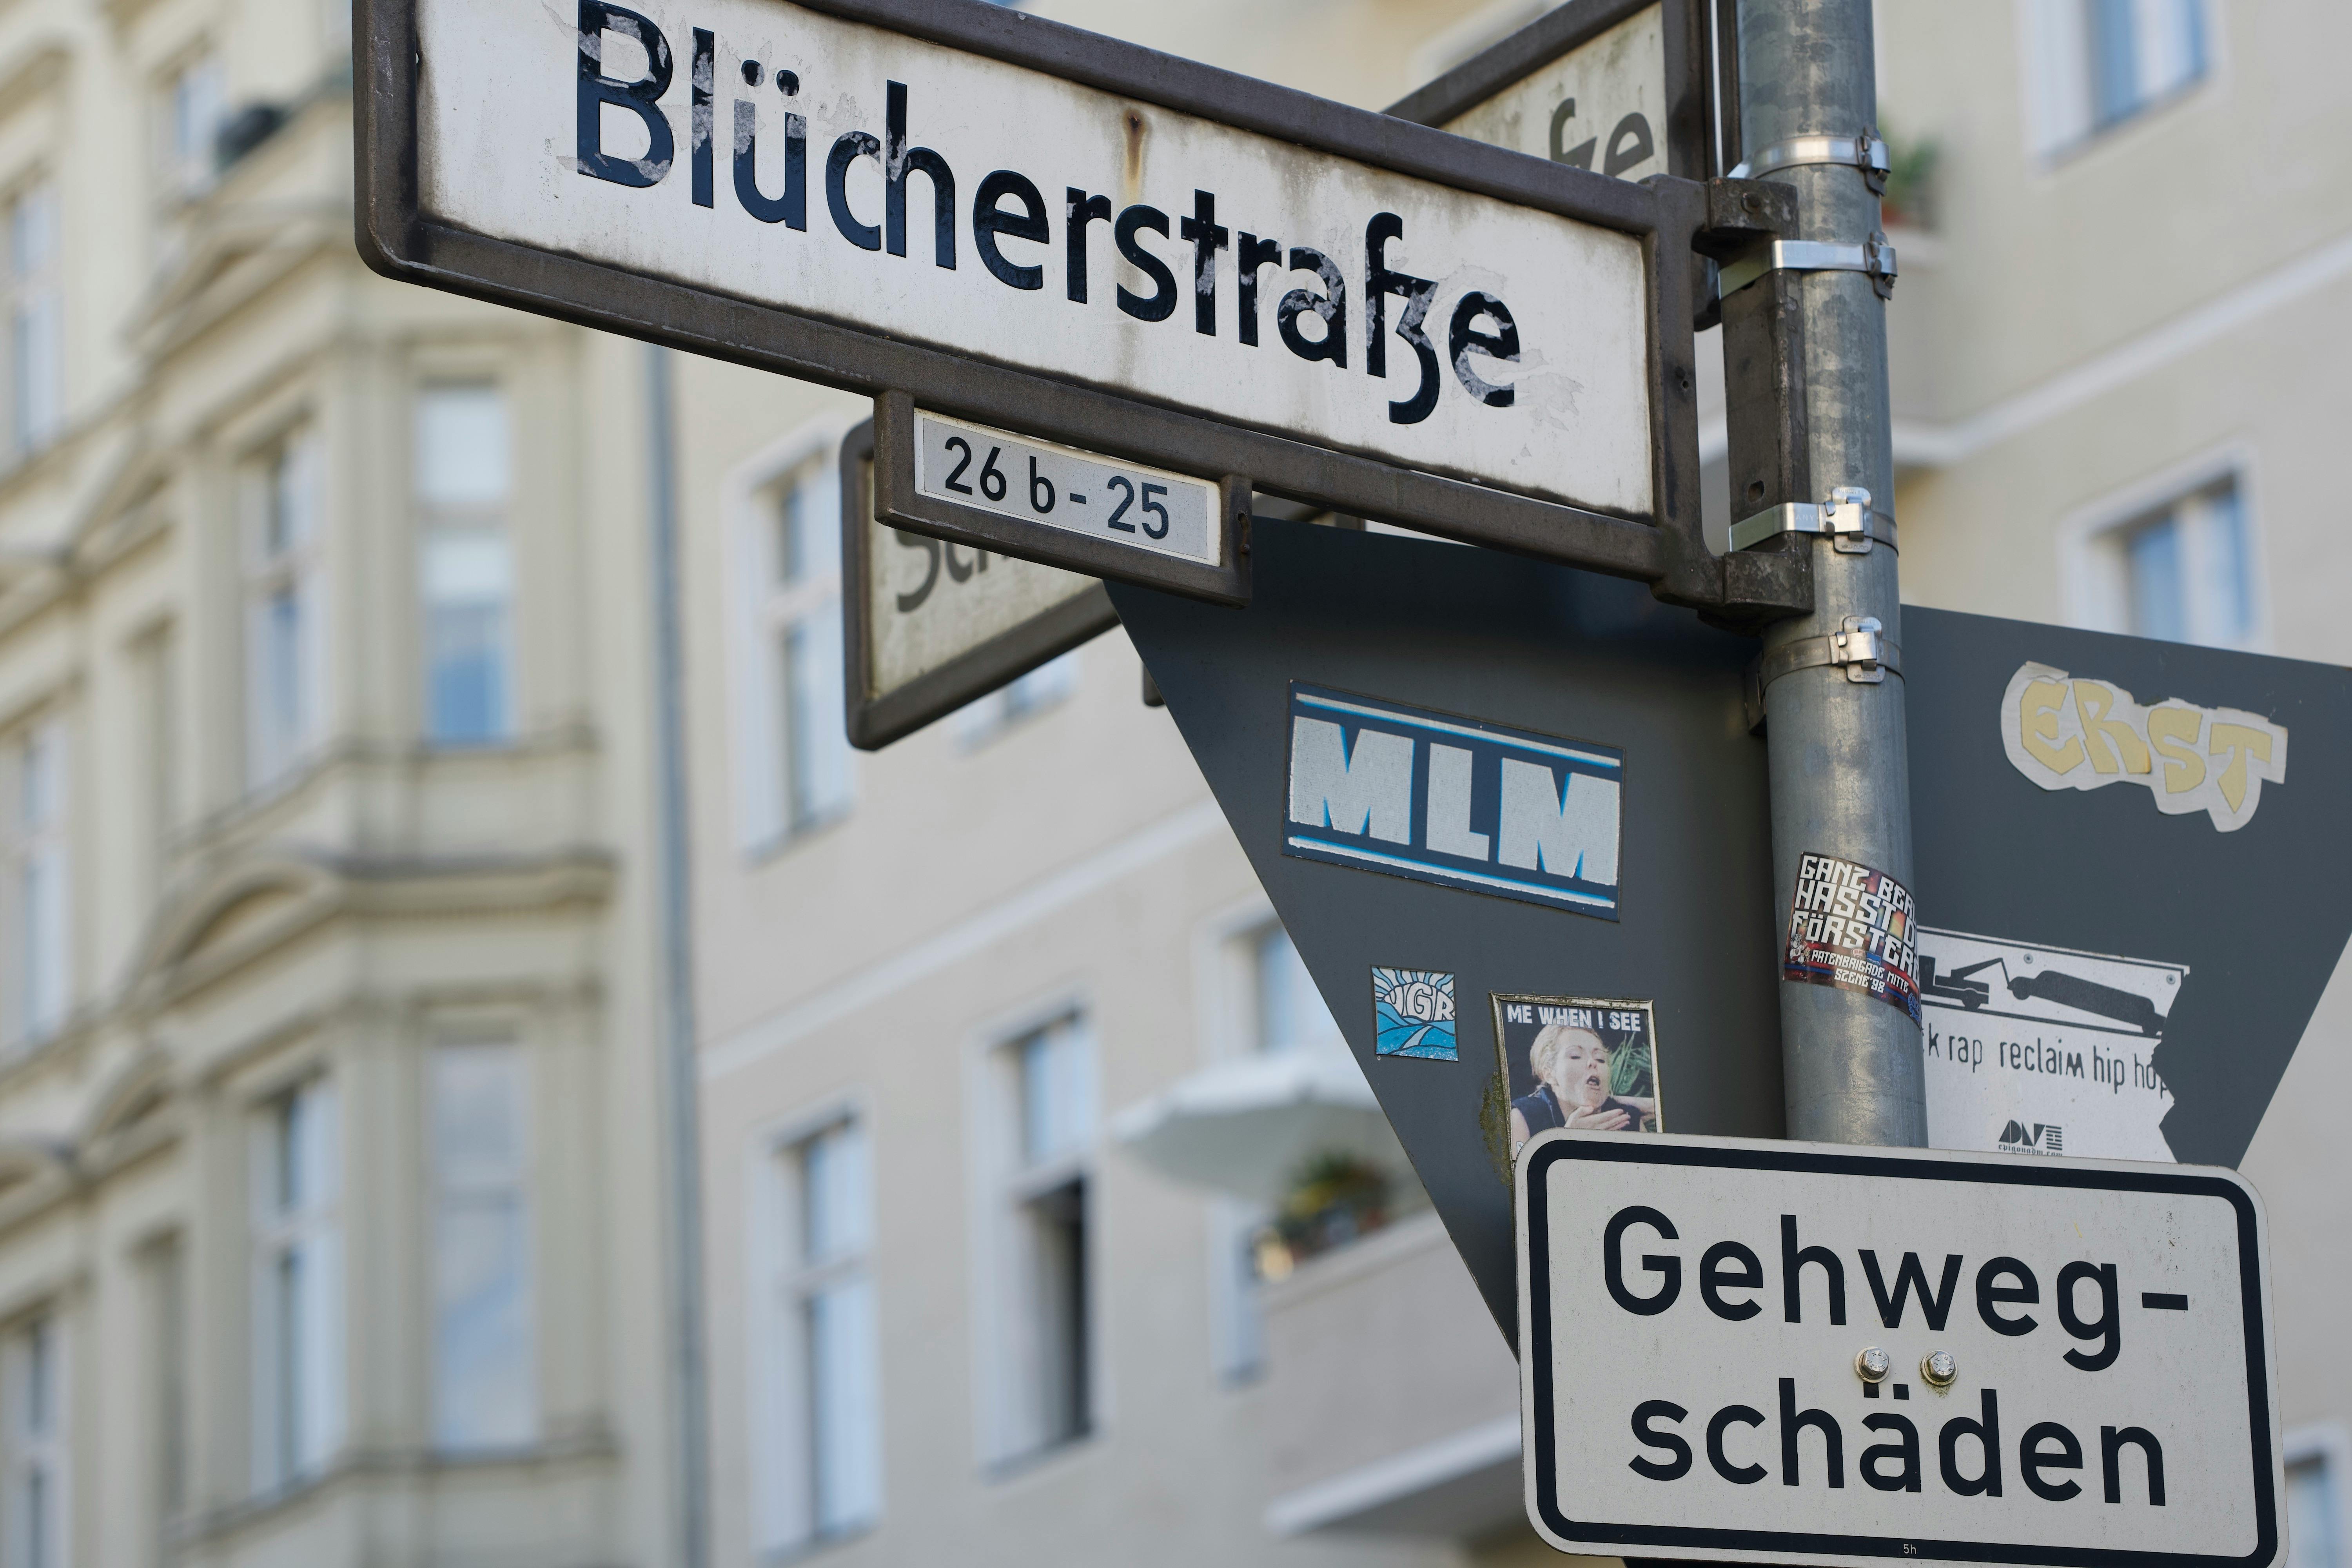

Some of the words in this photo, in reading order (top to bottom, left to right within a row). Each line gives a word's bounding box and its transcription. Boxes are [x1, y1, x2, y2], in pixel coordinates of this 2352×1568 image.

[577, 0, 1521, 424] Blücherstraße
[944, 436, 1007, 501] 26
[1029, 456, 1056, 514] b
[1107, 475, 1169, 540] 25
[2020, 680, 2272, 814] ERST
[1289, 716, 1620, 886] MLM
[1794, 878, 1897, 931] HASST
[1800, 855, 1870, 892] GANZ
[1877, 876, 1916, 925] BERL
[1811, 950, 1885, 978] PATENBRIGADE
[1886, 971, 1909, 994] MITTE
[1506, 1004, 1533, 1024] ME
[1538, 1006, 1592, 1029] WHEN
[1597, 1010, 1604, 1029] I
[1609, 1011, 1641, 1032] SEE
[1949, 1034, 1983, 1073] rap
[2093, 1045, 2125, 1094] hip
[1603, 1205, 2189, 1372] Gehweg-
[1628, 1377, 2167, 1508] schäden
[1903, 1543, 1917, 1555] 5h
